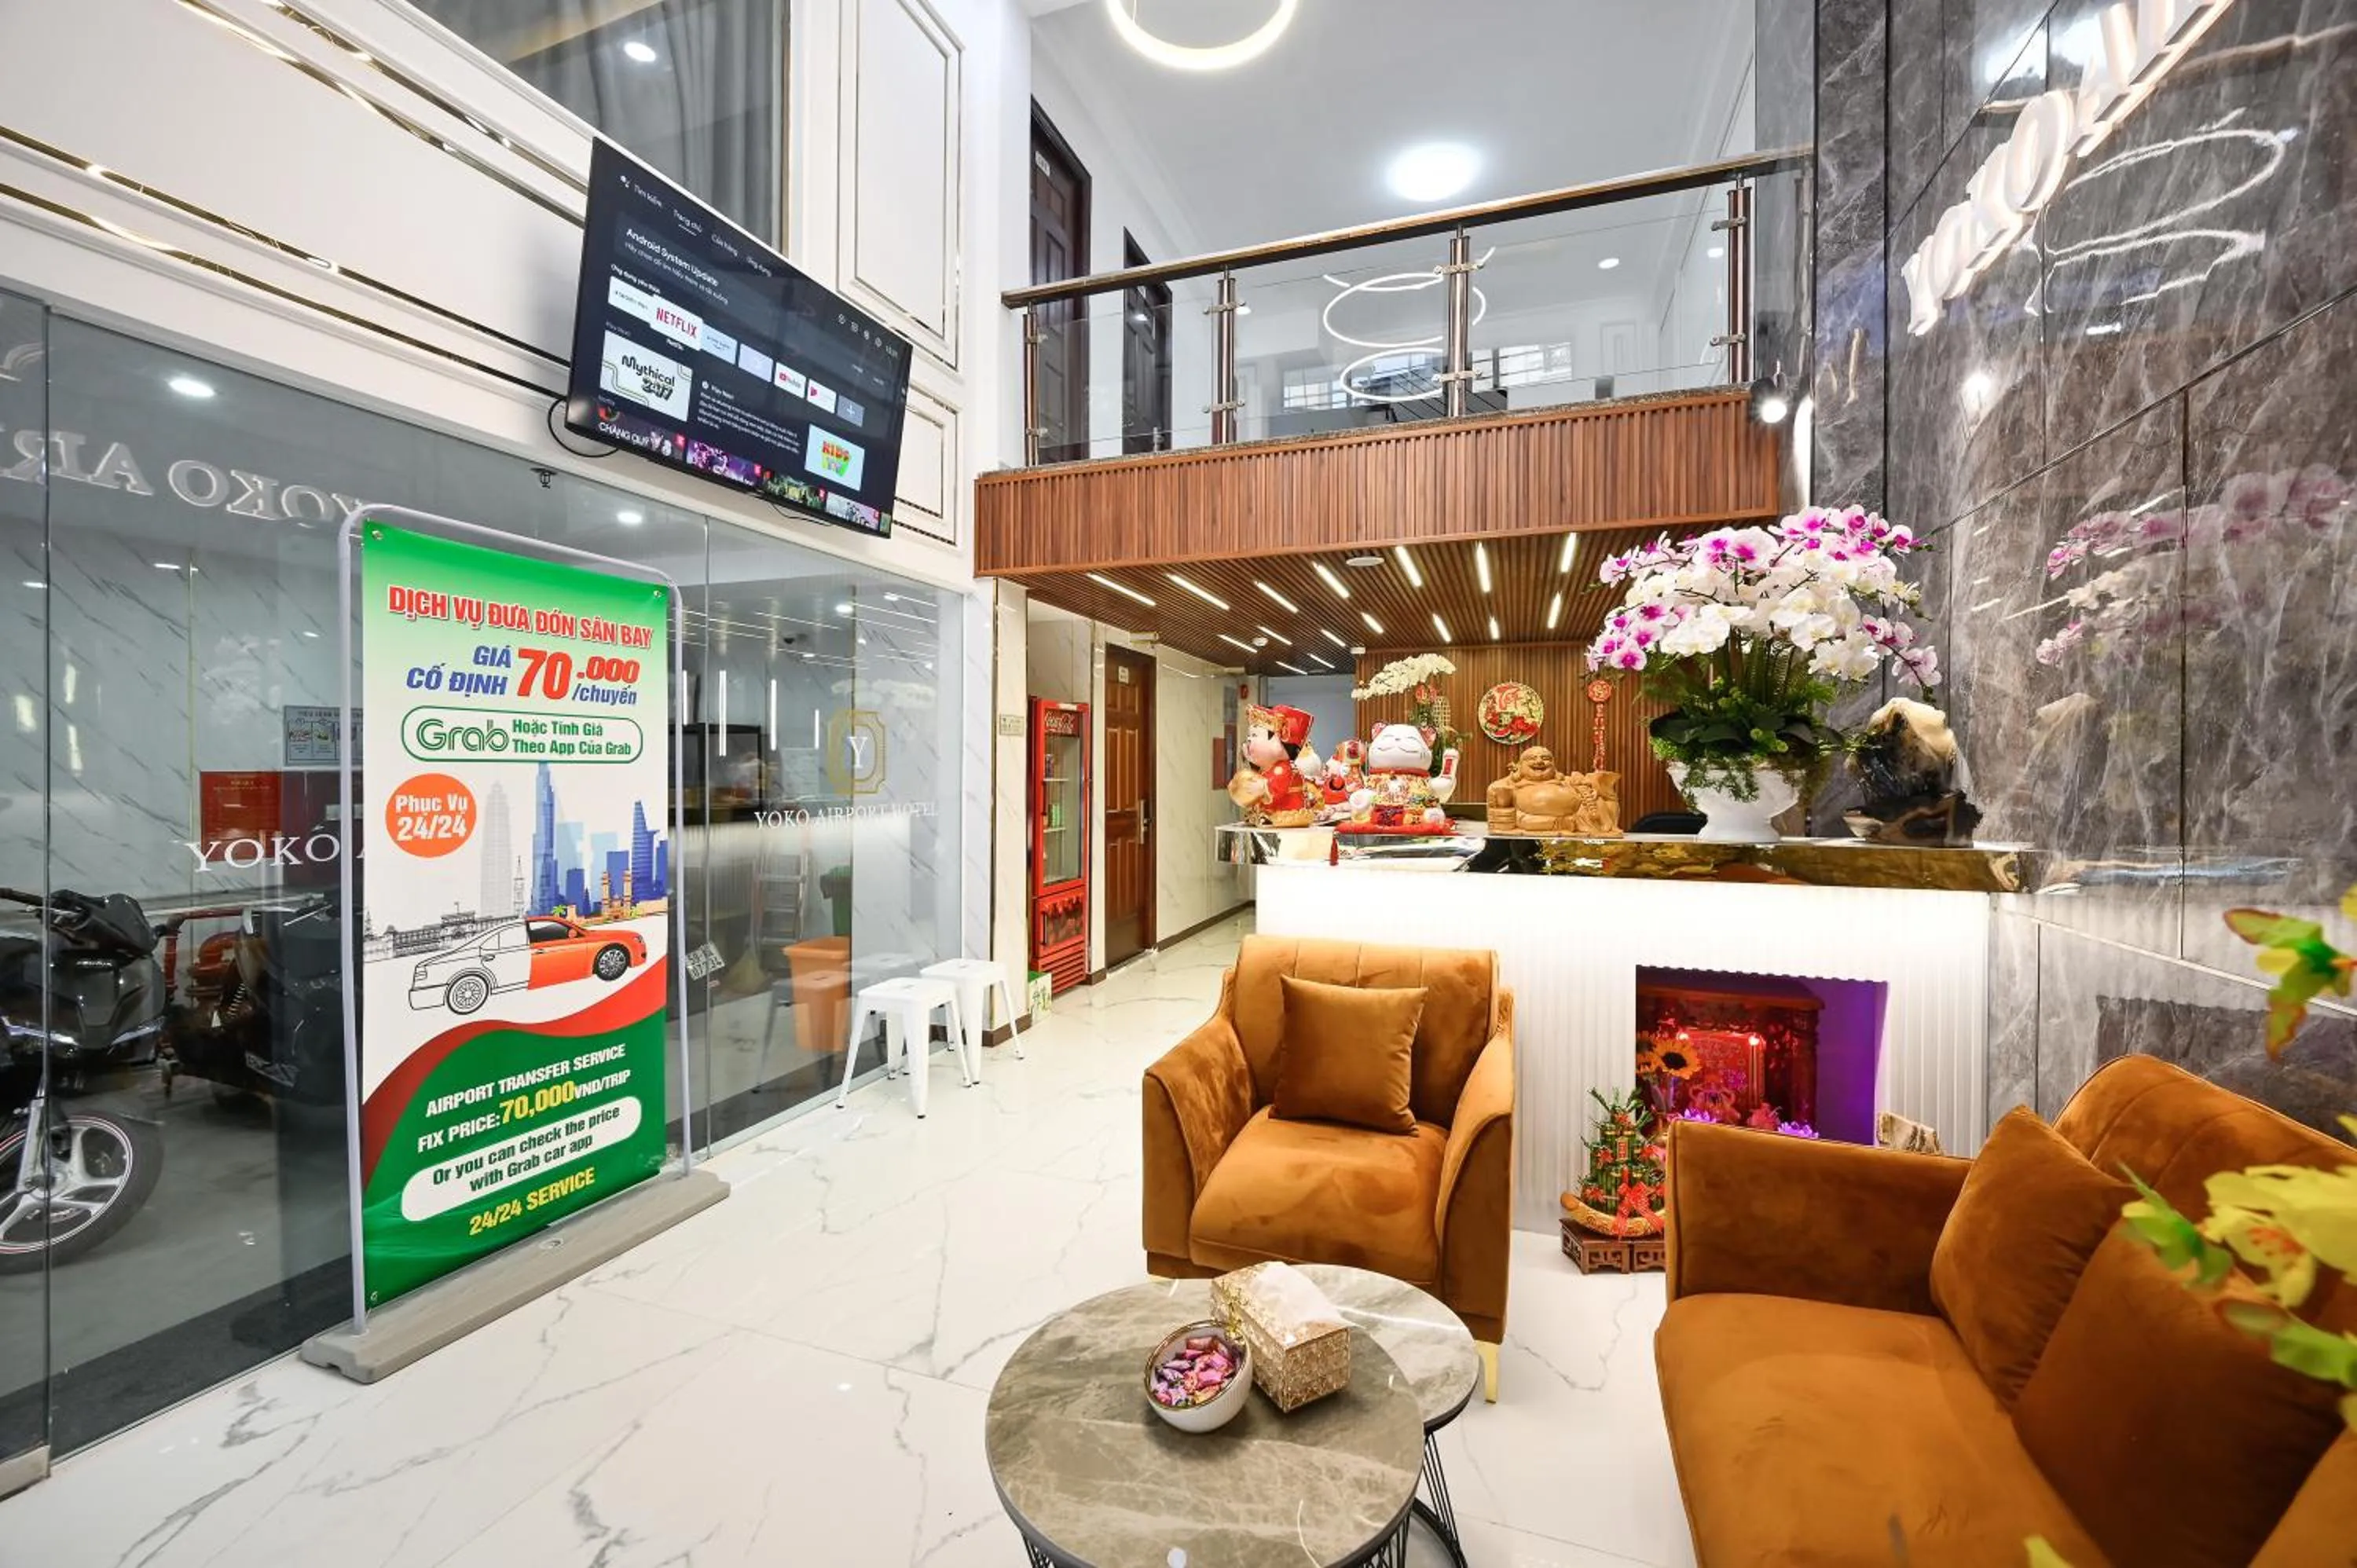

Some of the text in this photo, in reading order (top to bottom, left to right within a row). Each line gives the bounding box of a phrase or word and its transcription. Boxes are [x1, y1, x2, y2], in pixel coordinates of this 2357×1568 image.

[626, 227, 660, 254] Android
[661, 247, 690, 273] System
[656, 308, 698, 339] NETFLIX
[621, 355, 675, 387] Mythical
[388, 584, 653, 648] DỊCH VỤ ĐƯA ĐÓN SÂN BAY
[473, 645, 511, 668] GIÁ
[407, 663, 445, 690] CỐ
[449, 672, 508, 697] ĐỊNH
[416, 719, 509, 752] Grab
[512, 719, 603, 737] Hoặc Tính Giá
[512, 738, 631, 756] Theo App Của Grab
[848, 736, 867, 769] Y
[395, 793, 467, 816] Phục Vụ
[754, 809, 810, 830] YOKO
[397, 815, 467, 841] 24/24
[183, 833, 341, 872] YOKO
[425, 1043, 626, 1118] AIRPORT TRANSFER SERVICE
[417, 1129, 445, 1153] FIX
[448, 1112, 500, 1142] PRICE:
[433, 1106, 621, 1185] Or you can check the price
[469, 1134, 593, 1192] with Grab car app
[469, 1167, 596, 1236] 24/24 SERVICE
